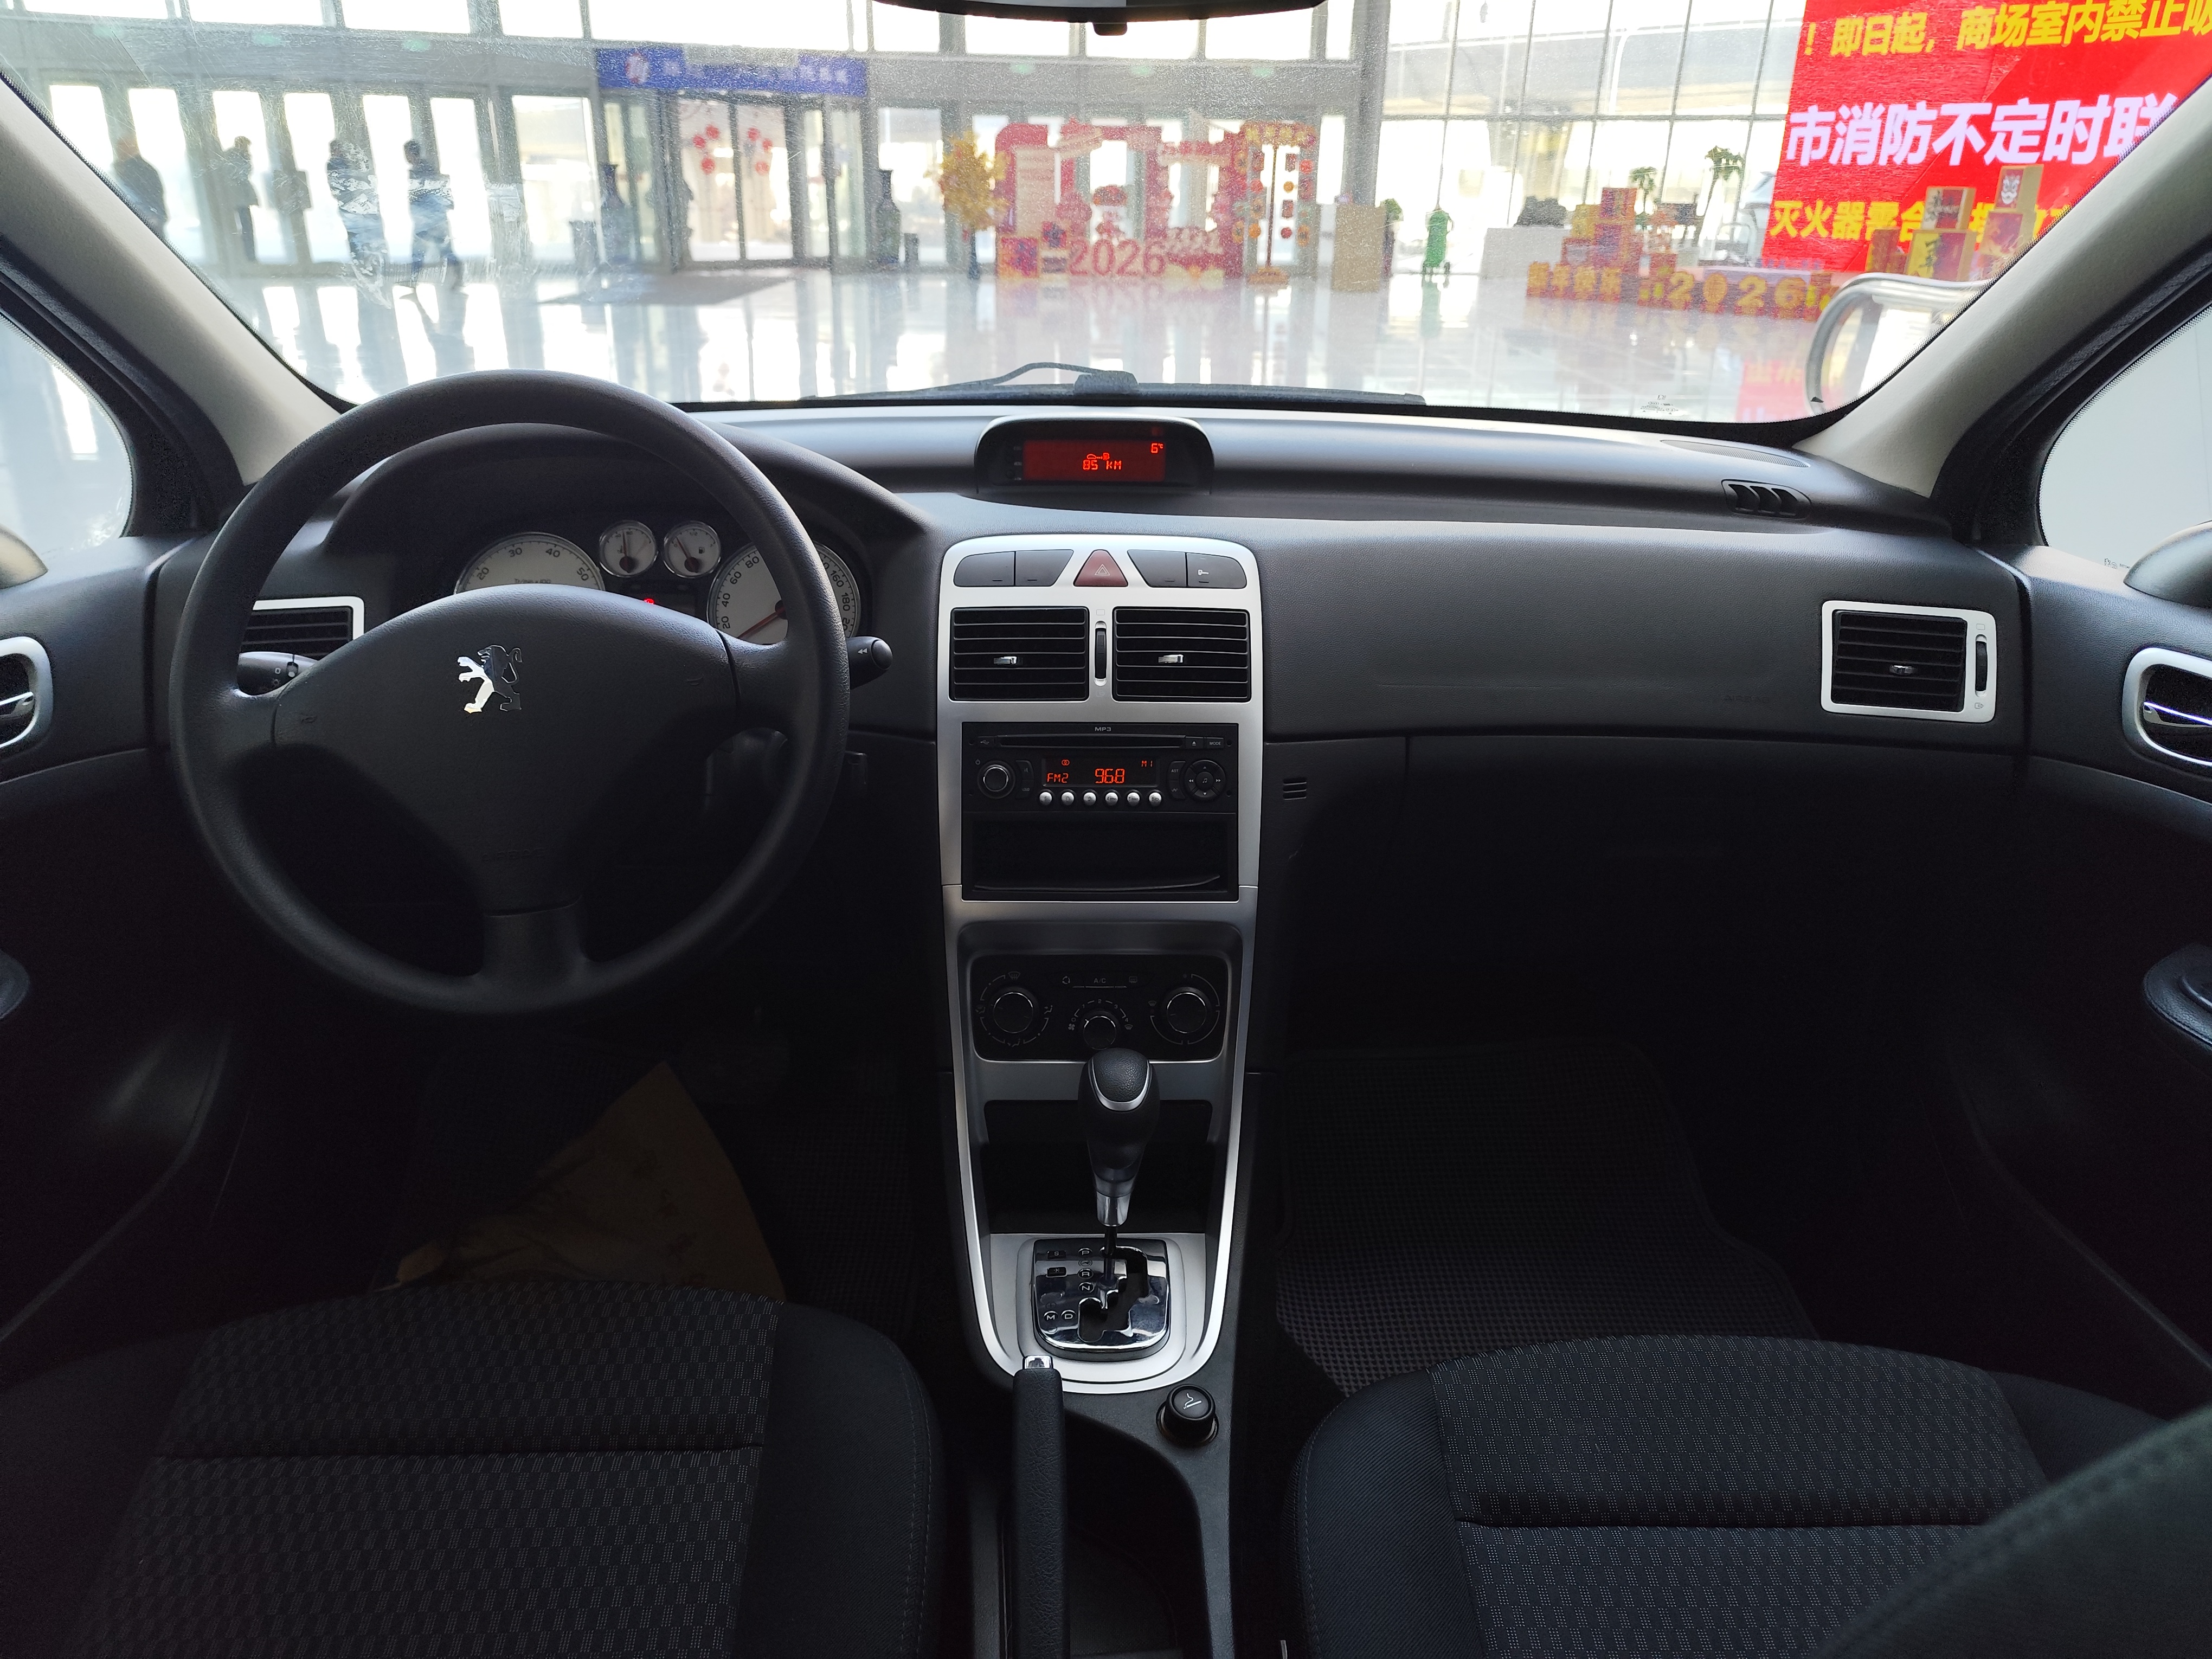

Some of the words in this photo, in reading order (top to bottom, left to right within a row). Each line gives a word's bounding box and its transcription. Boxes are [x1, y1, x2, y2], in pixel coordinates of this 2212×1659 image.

[1070, 239, 1166, 276] 2026
[1668, 272, 1806, 310] 2026
[1106, 460, 1122, 470] KM
[509, 548, 523, 557] 30
[545, 548, 561, 558] 40
[745, 556, 760, 569] 80
[477, 567, 490, 581] 20
[576, 567, 589, 581] 50
[730, 571, 742, 585] 60
[830, 570, 844, 587] 160
[722, 593, 731, 607] 40
[841, 592, 851, 612] 180
[722, 616, 731, 629] 20
[1047, 773, 1069, 783] FM2
